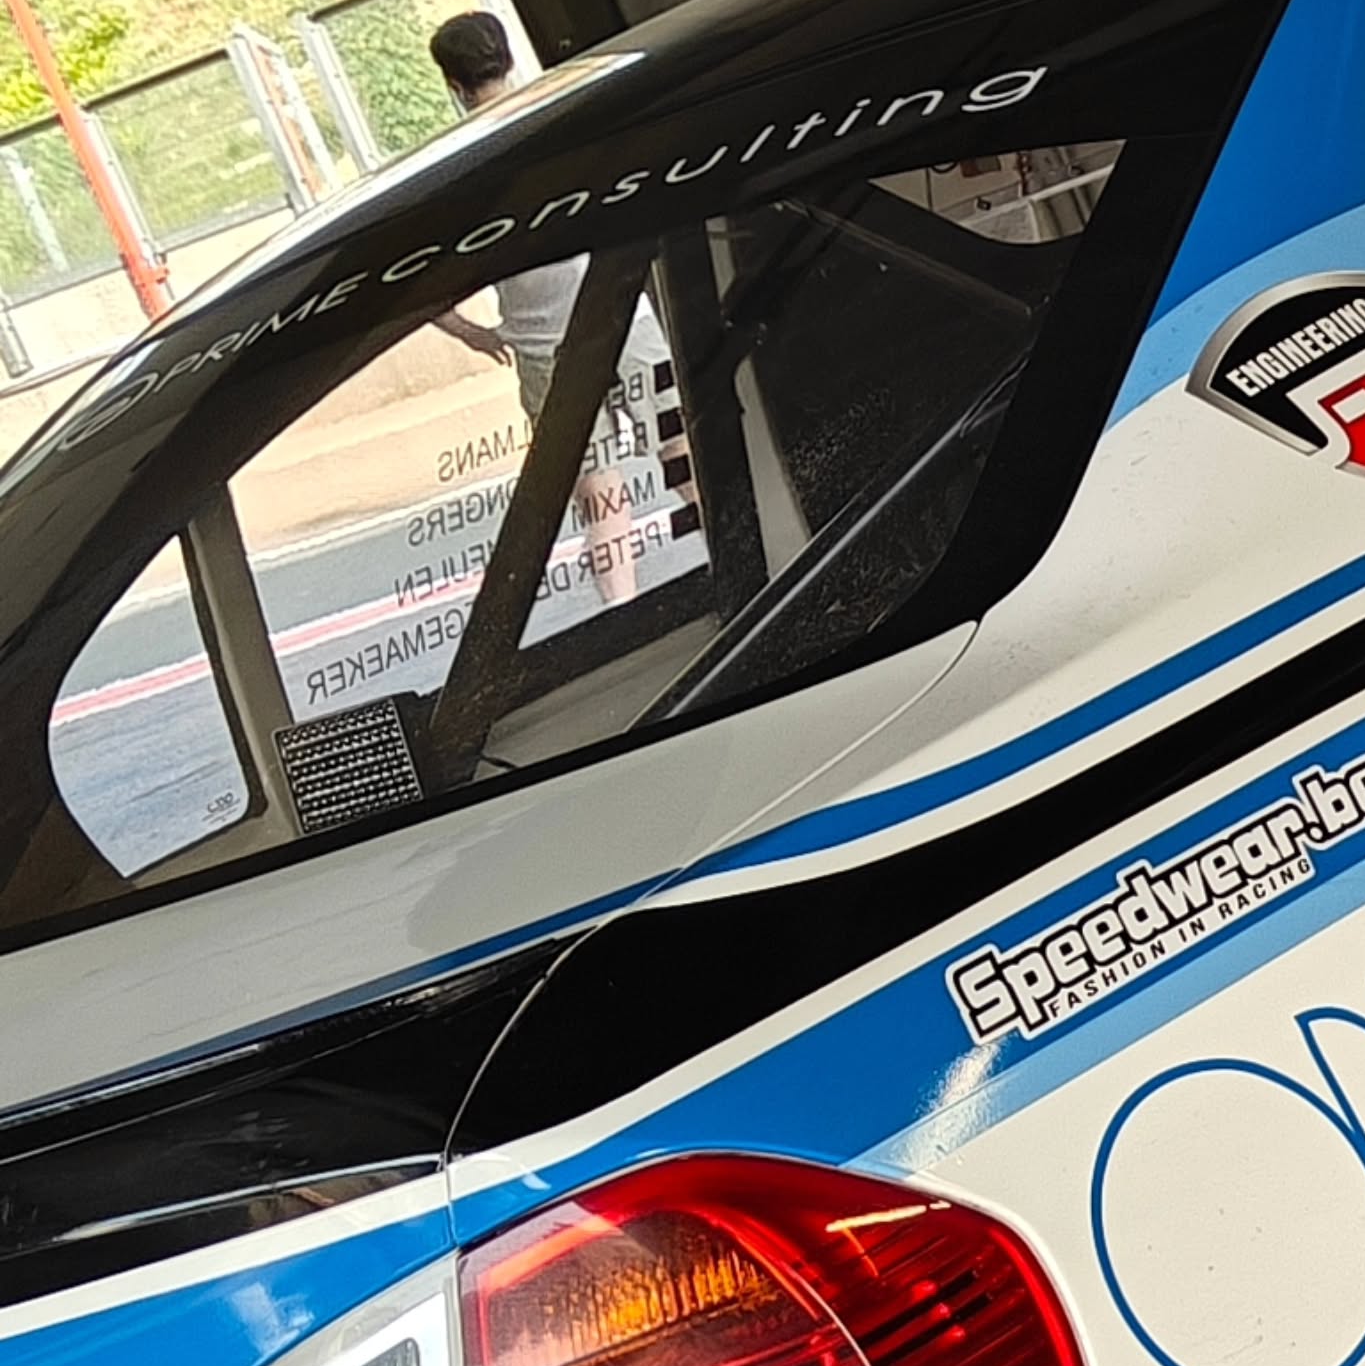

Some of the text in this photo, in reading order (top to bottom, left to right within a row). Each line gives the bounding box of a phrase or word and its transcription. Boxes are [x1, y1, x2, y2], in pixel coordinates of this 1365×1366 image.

[152, 65, 1048, 393] PRIME consulting
[1049, 857, 1312, 1018] FASHION IN RACING
